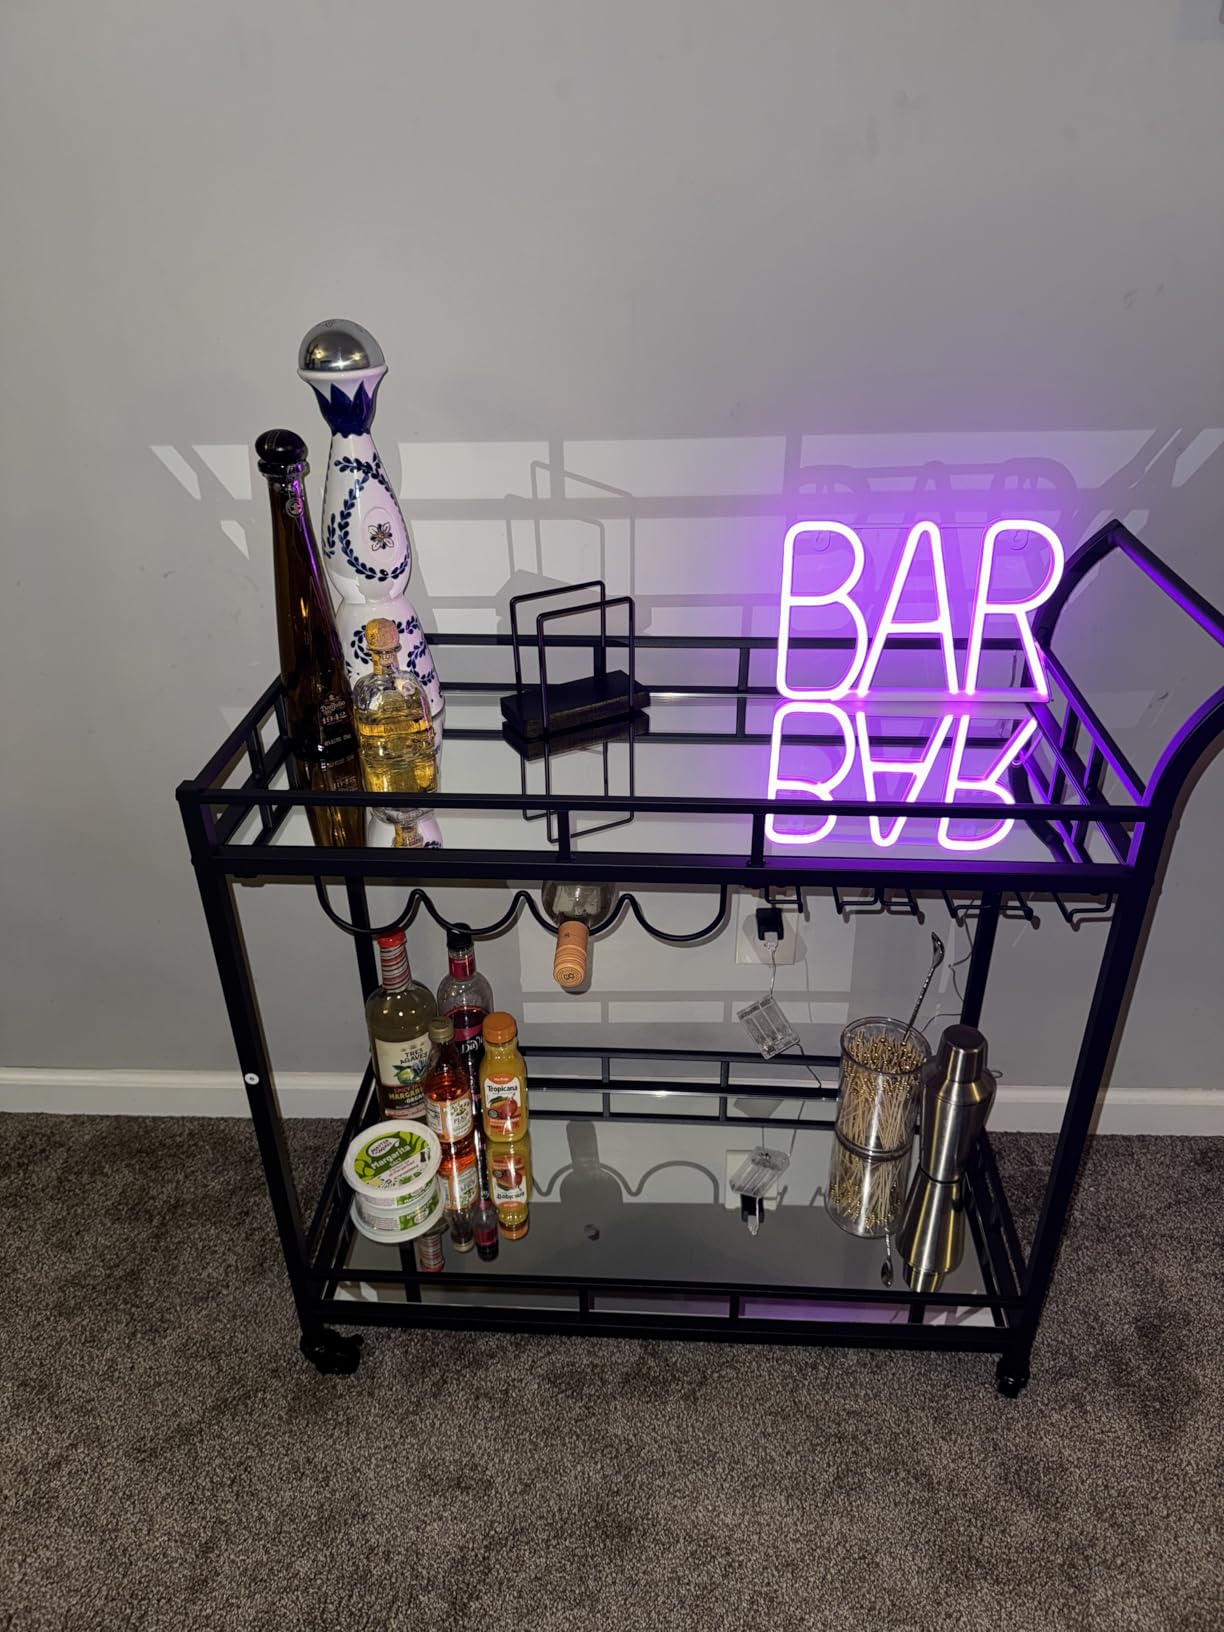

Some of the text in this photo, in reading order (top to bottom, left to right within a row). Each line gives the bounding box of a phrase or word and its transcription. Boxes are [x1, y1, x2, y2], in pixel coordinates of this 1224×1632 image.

[776, 520, 1049, 700] BAR
[388, 1087, 423, 1100] MARGARI
[487, 1085, 518, 1093] Tropicana
[371, 1145, 411, 1169] Margarita
